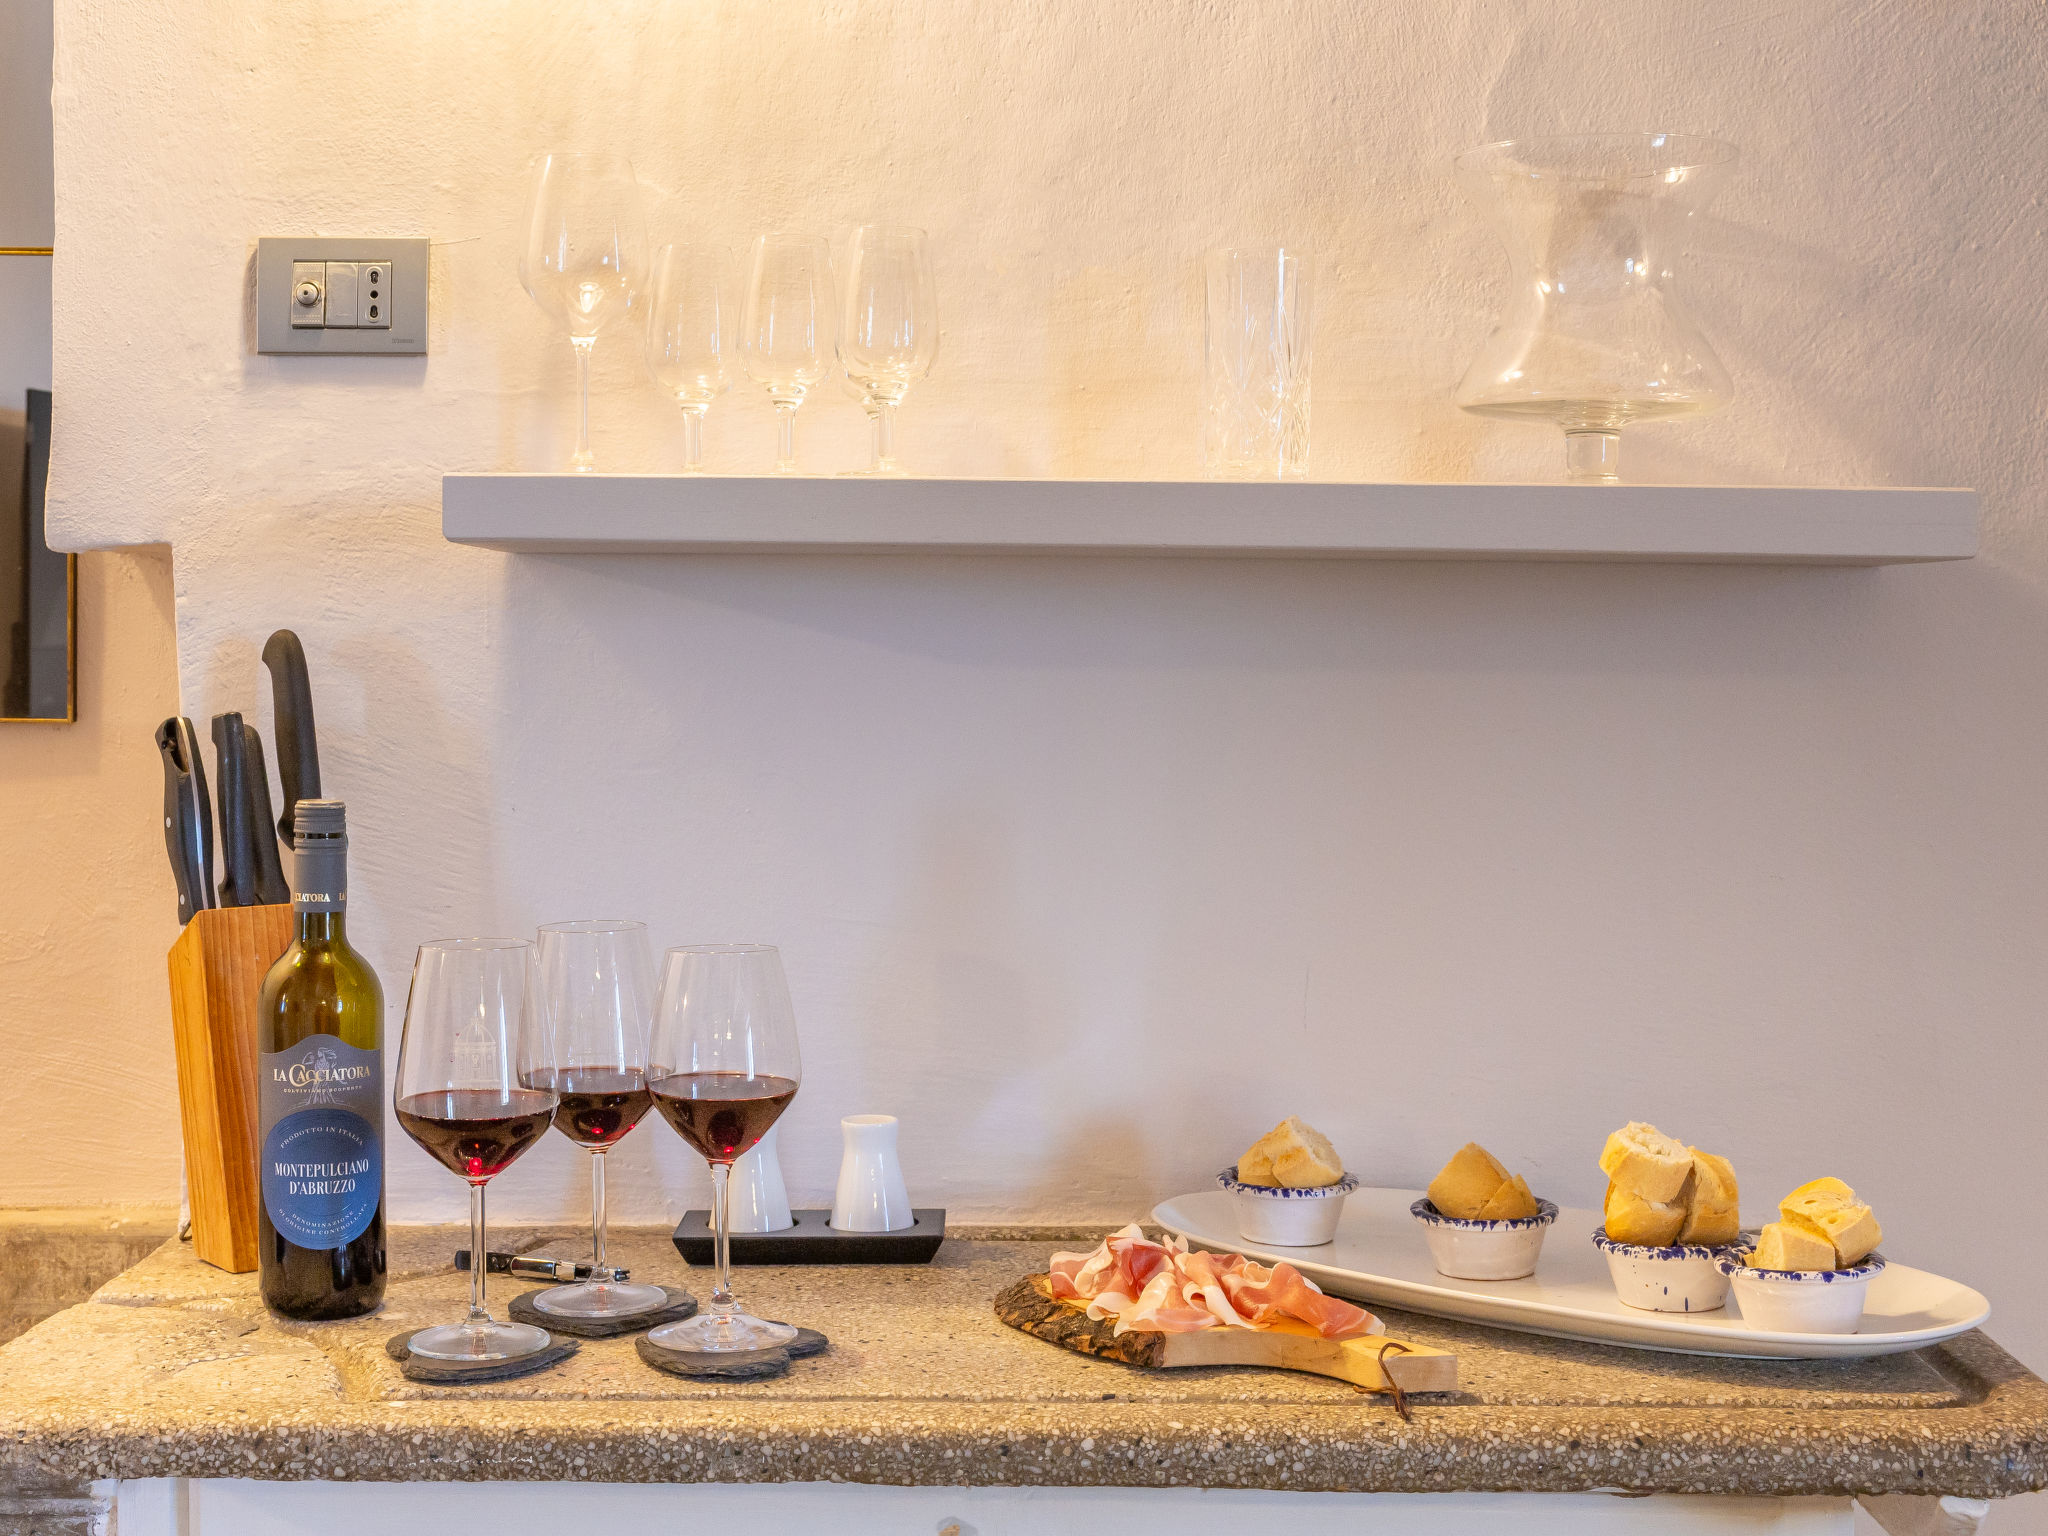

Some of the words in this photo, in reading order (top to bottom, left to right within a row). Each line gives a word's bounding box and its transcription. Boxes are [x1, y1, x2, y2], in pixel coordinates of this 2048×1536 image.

[273, 1068, 287, 1082] LA
[289, 1064, 371, 1087] CACCIATORA
[280, 1126, 323, 1149] PRODOTTO
[338, 1128, 363, 1146] ITALIA
[274, 1158, 369, 1178] MONTEPULCIANO
[289, 1179, 356, 1195] D'ABRUZZO
[278, 1208, 285, 1217] DI
[285, 1217, 316, 1235] ORIGINE
[318, 1203, 367, 1235] CONTROLLATA
[292, 1210, 354, 1228] DENOMINAZIONE
